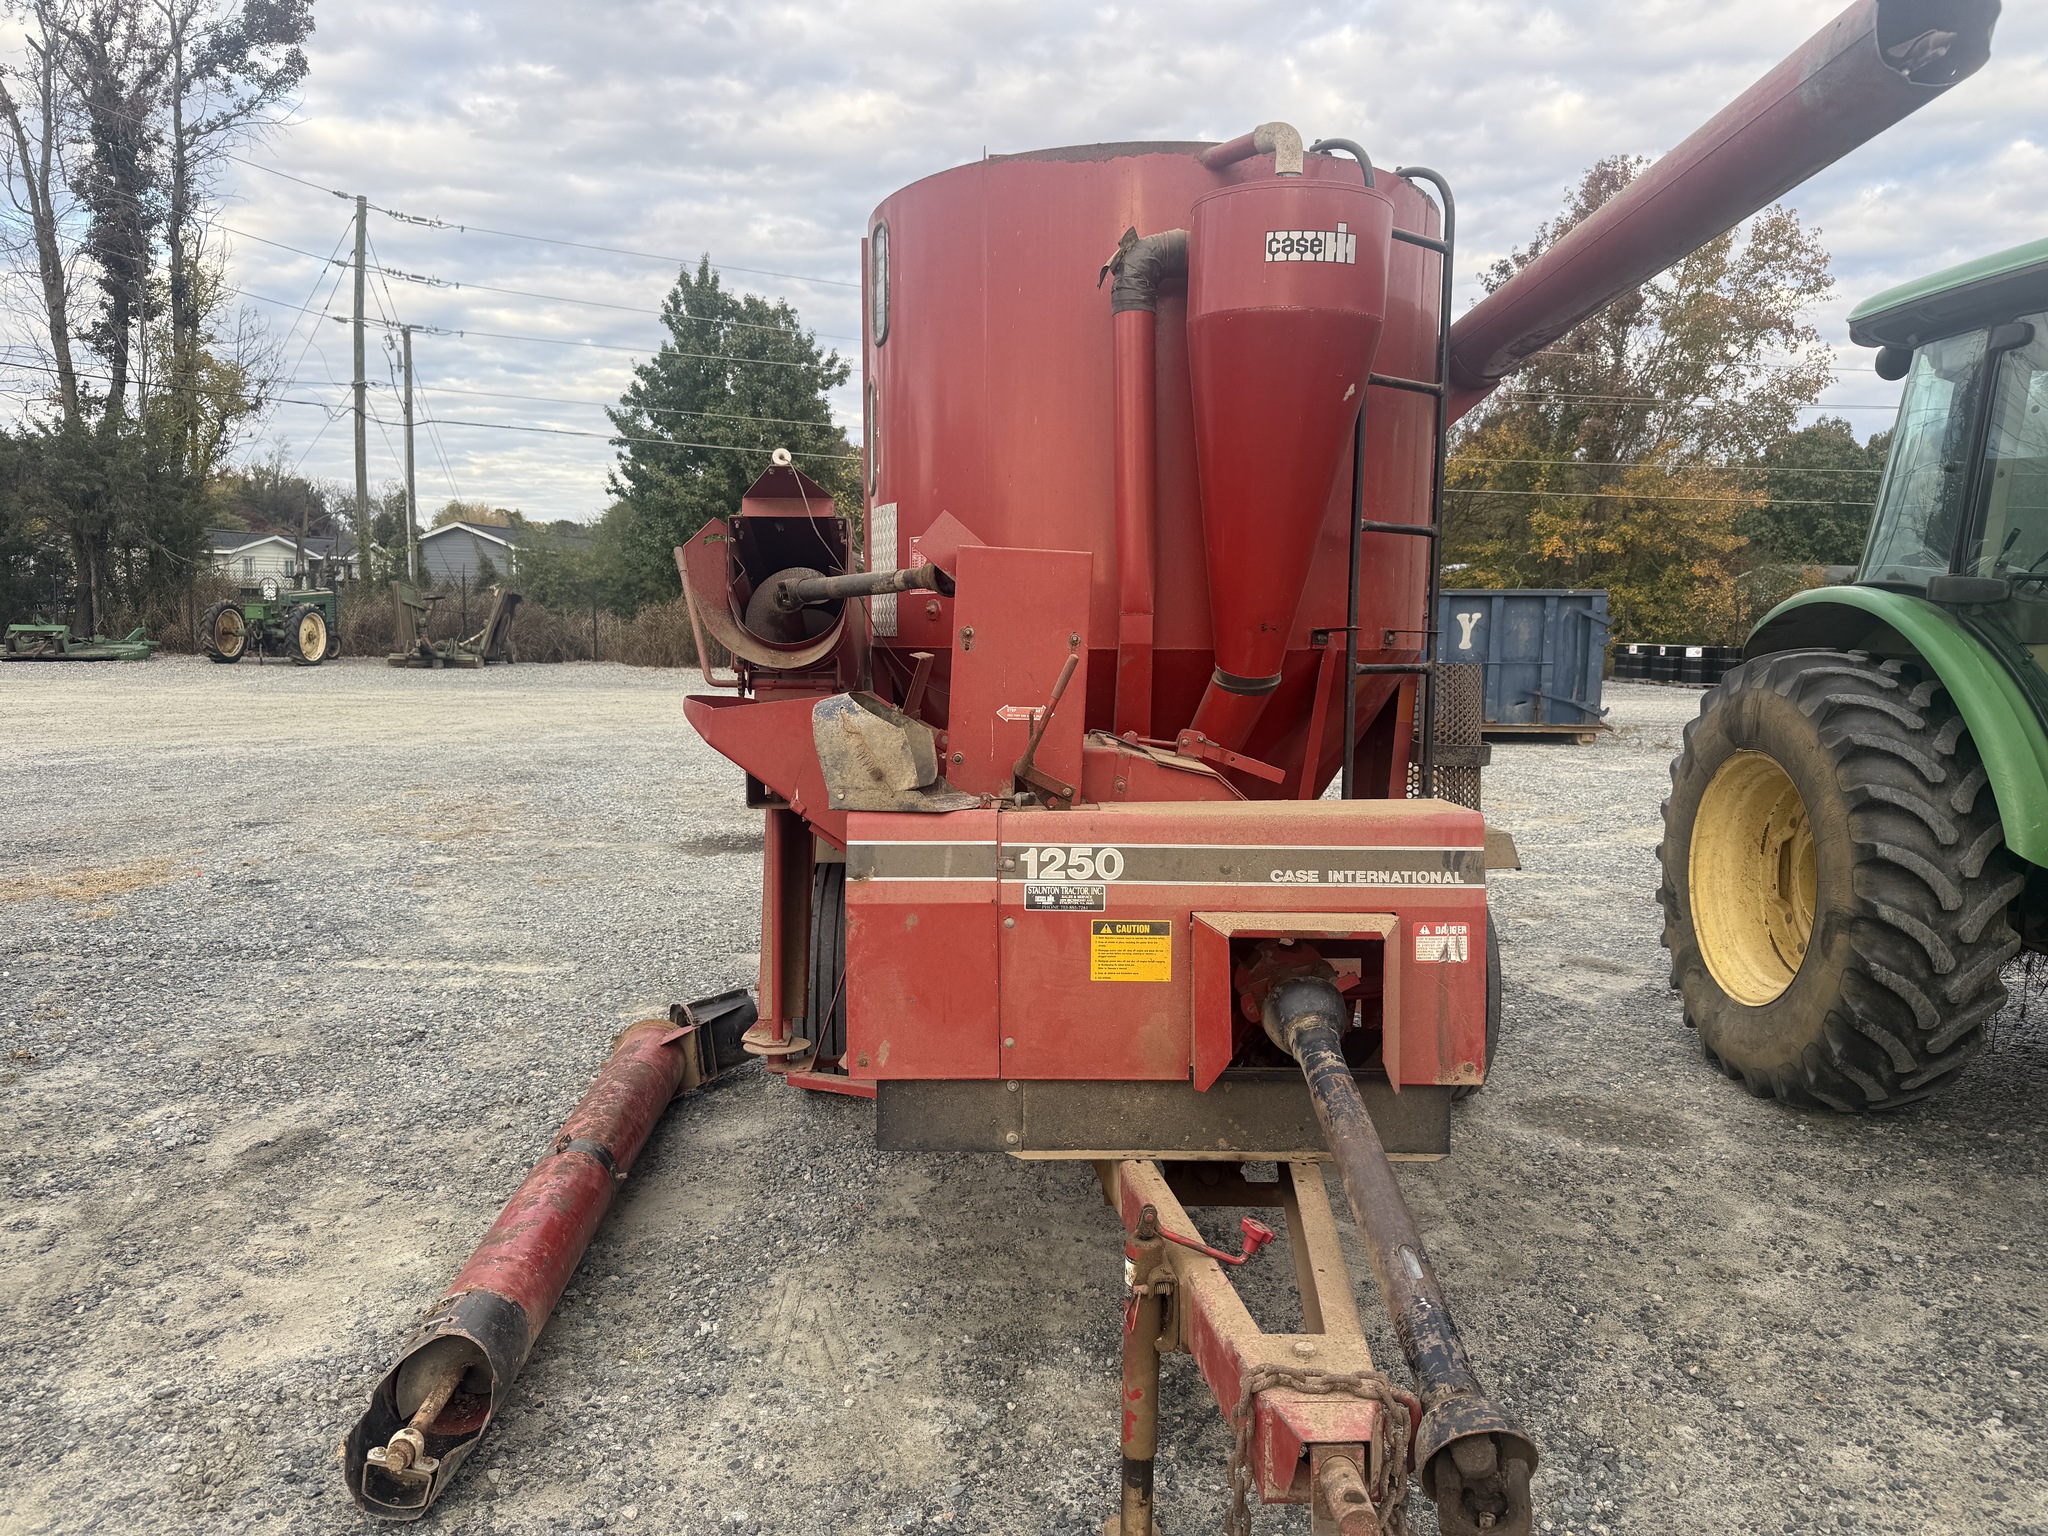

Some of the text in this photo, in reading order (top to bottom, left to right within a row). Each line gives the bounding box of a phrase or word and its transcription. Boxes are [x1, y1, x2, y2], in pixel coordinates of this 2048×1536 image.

[1456, 612, 1482, 650] Y
[1020, 847, 1124, 880] 1250
[1270, 869, 1465, 884] CASE INTERNATIONAL
[1028, 886, 1059, 895] STAUNTON
[1091, 886, 1103, 895] INC.
[1115, 924, 1150, 934] CAUTION
